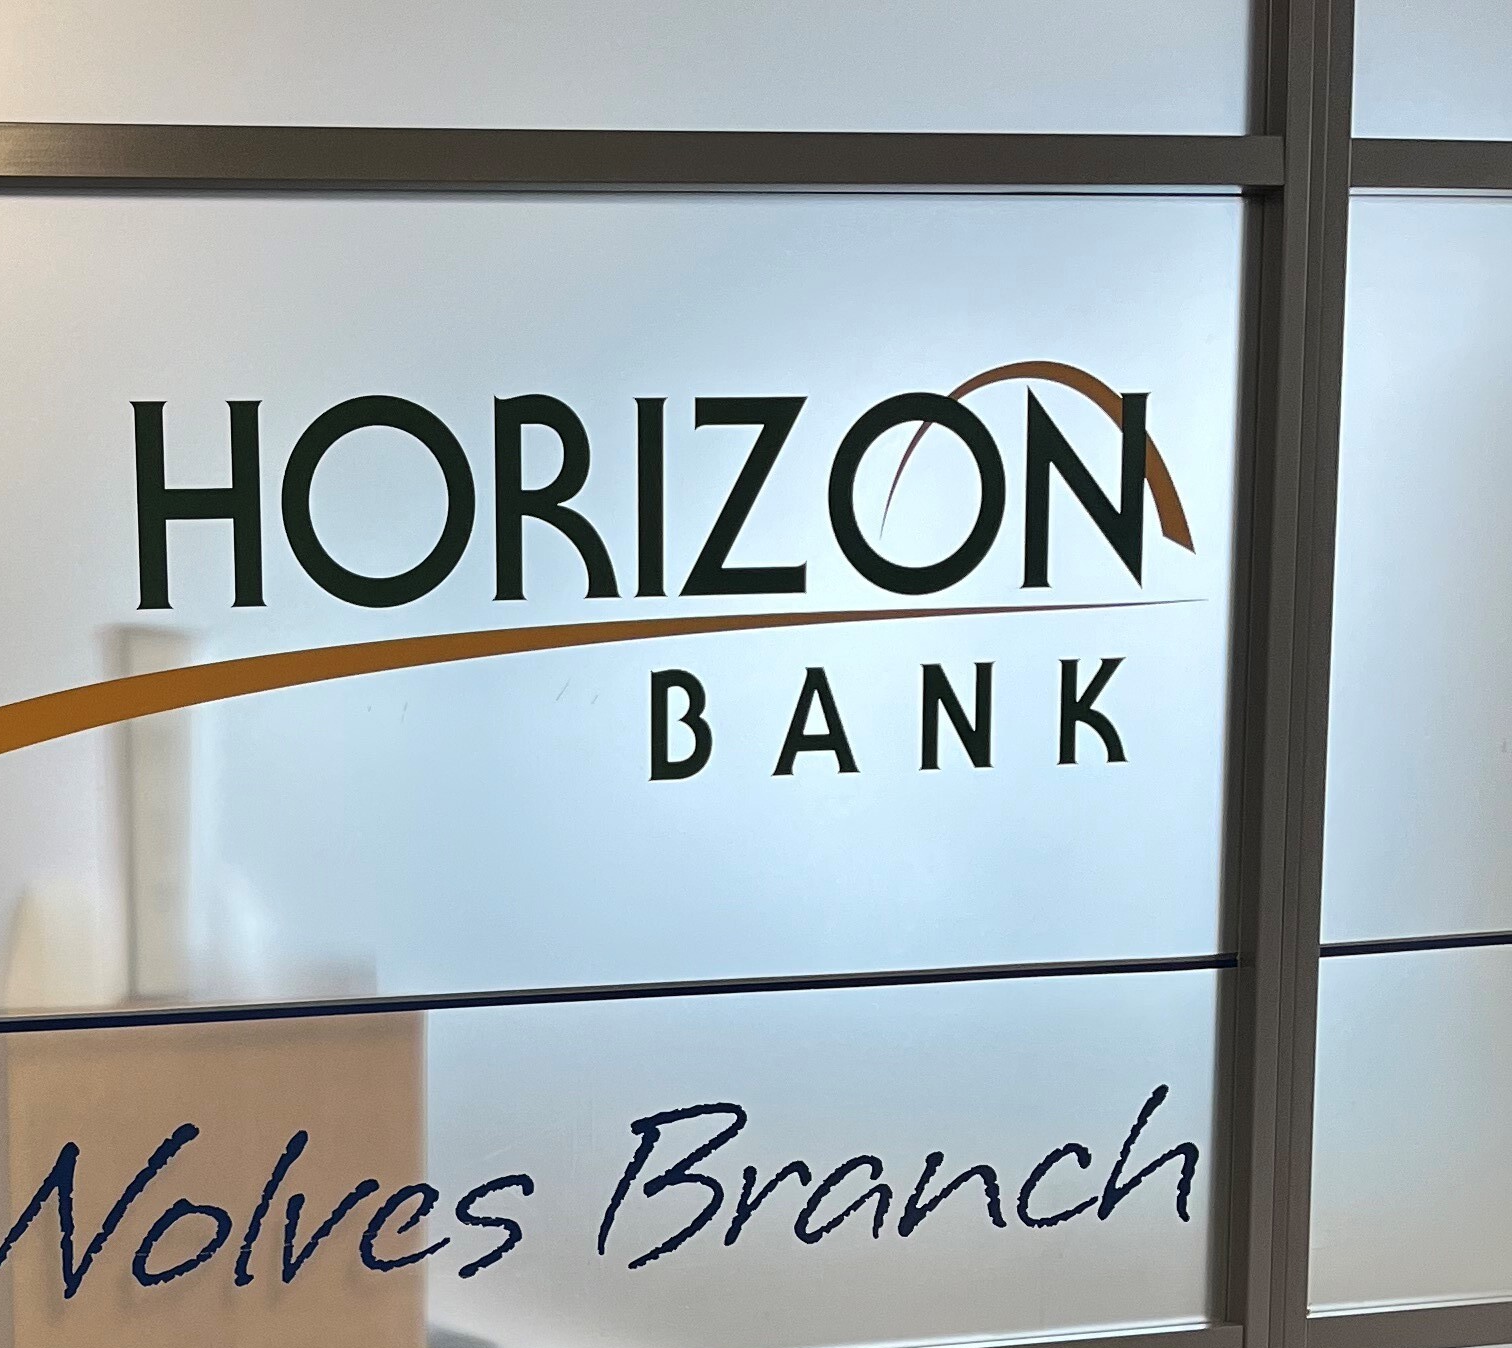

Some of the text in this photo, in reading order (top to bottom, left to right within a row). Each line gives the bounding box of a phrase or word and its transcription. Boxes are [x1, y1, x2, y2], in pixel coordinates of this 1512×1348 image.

[130, 393, 1152, 610] HORIZON
[650, 657, 1126, 781] BANK
[598, 1084, 1200, 1270] Branch
